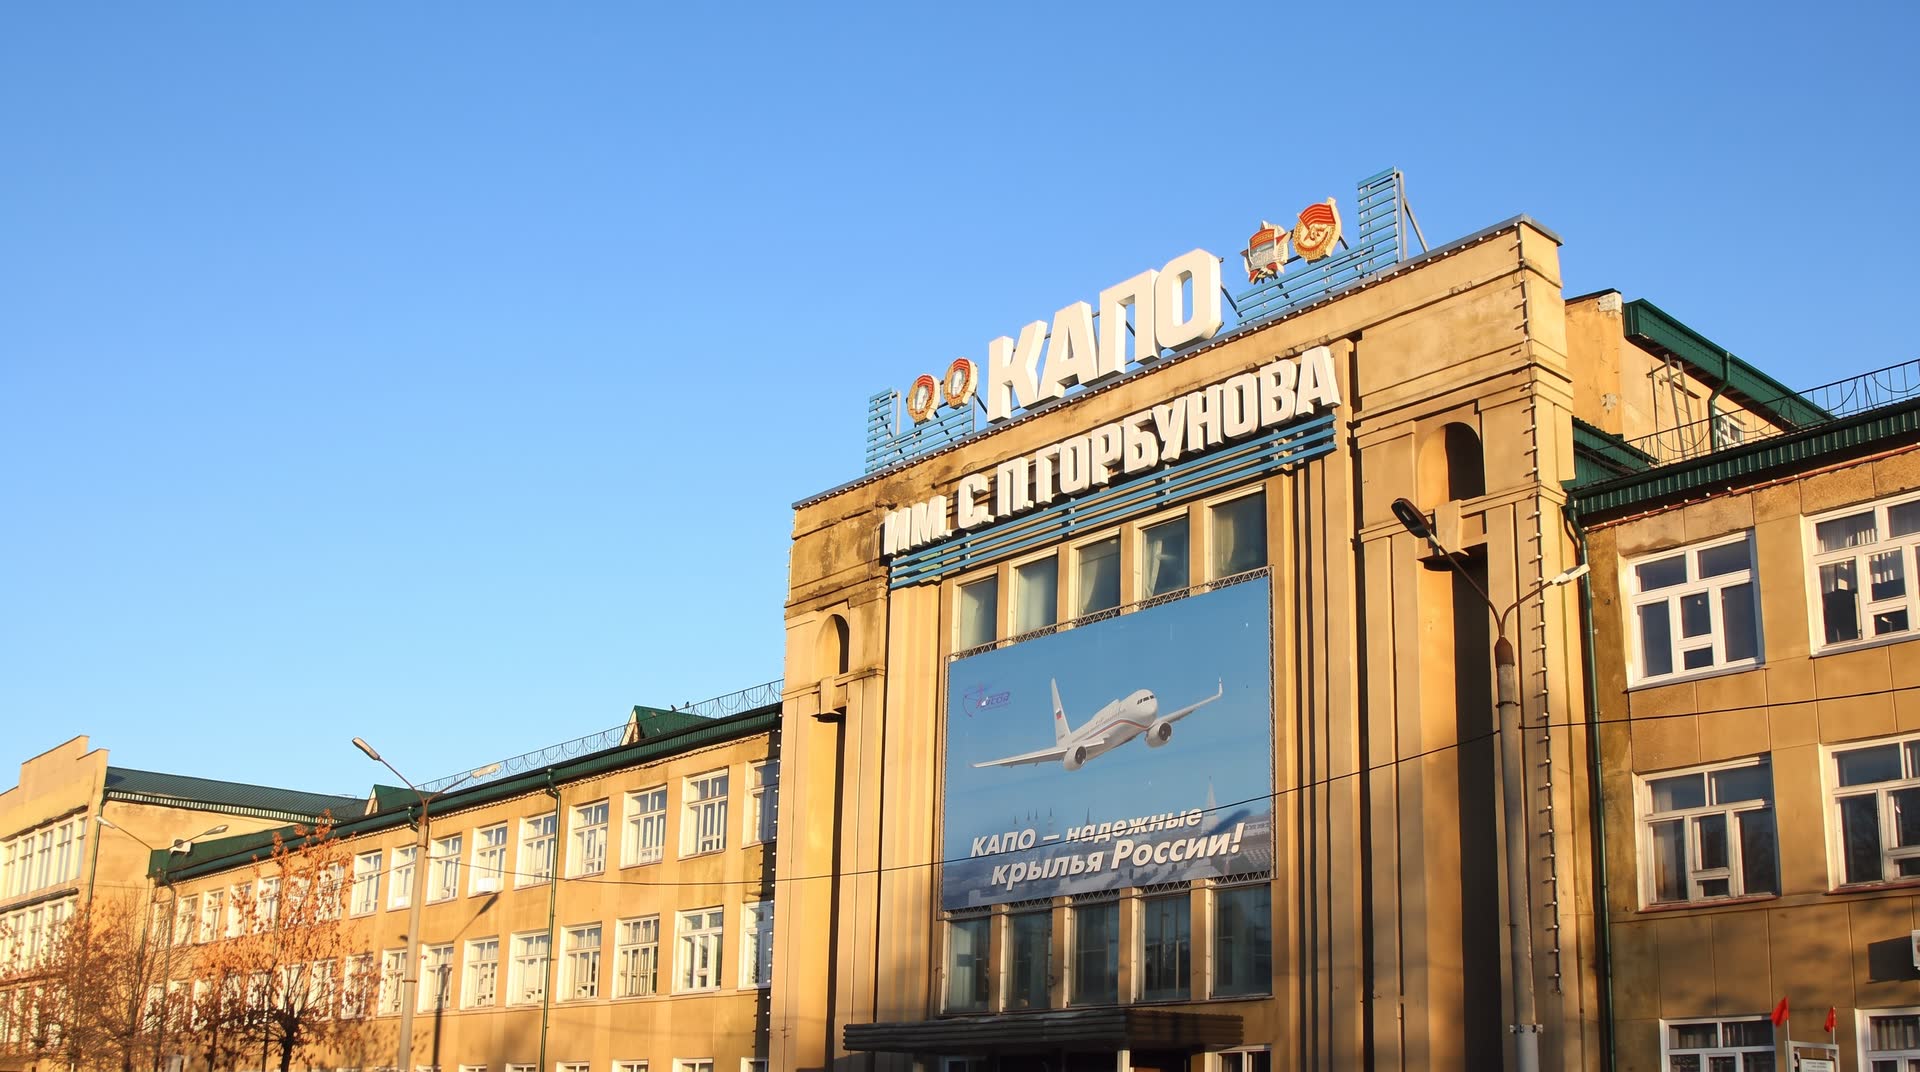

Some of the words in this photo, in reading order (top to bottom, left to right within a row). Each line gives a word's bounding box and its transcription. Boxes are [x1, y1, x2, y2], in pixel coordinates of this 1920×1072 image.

[987, 248, 1222, 423] КАПО
[884, 495, 952, 556] ИМ.
[970, 828, 1036, 858] КАПО
[1065, 808, 1203, 844] надежные
[991, 851, 1104, 891] крылья
[1111, 822, 1246, 870] России!
